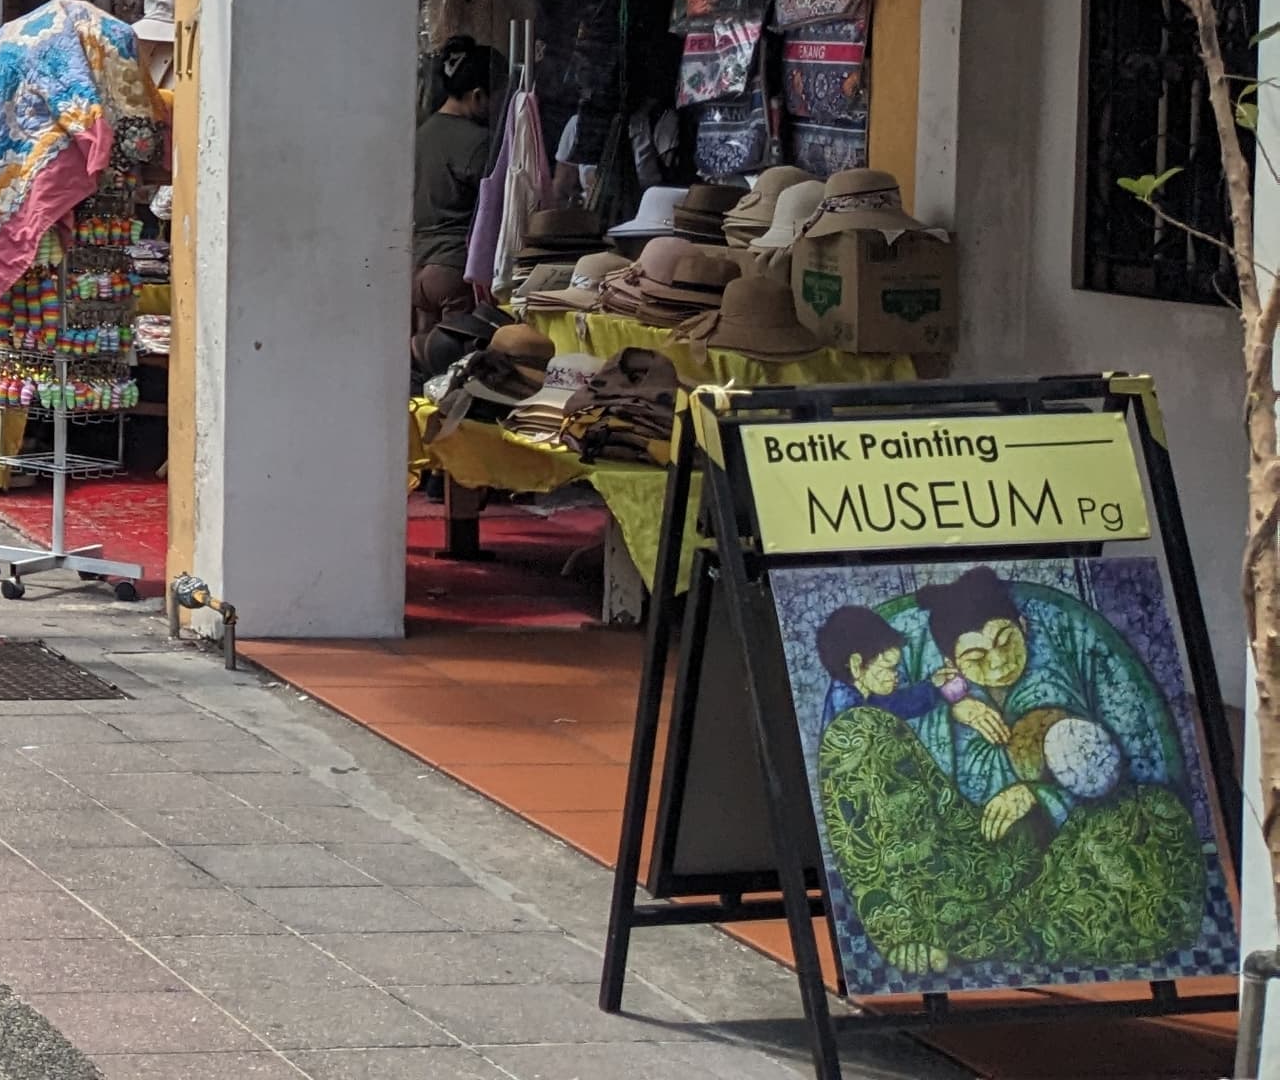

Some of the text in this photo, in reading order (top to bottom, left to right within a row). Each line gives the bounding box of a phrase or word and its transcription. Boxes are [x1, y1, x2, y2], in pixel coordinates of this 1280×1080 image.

[765, 429, 1000, 463] Batik Painting
[807, 477, 1125, 535] MUSEUM Pg
